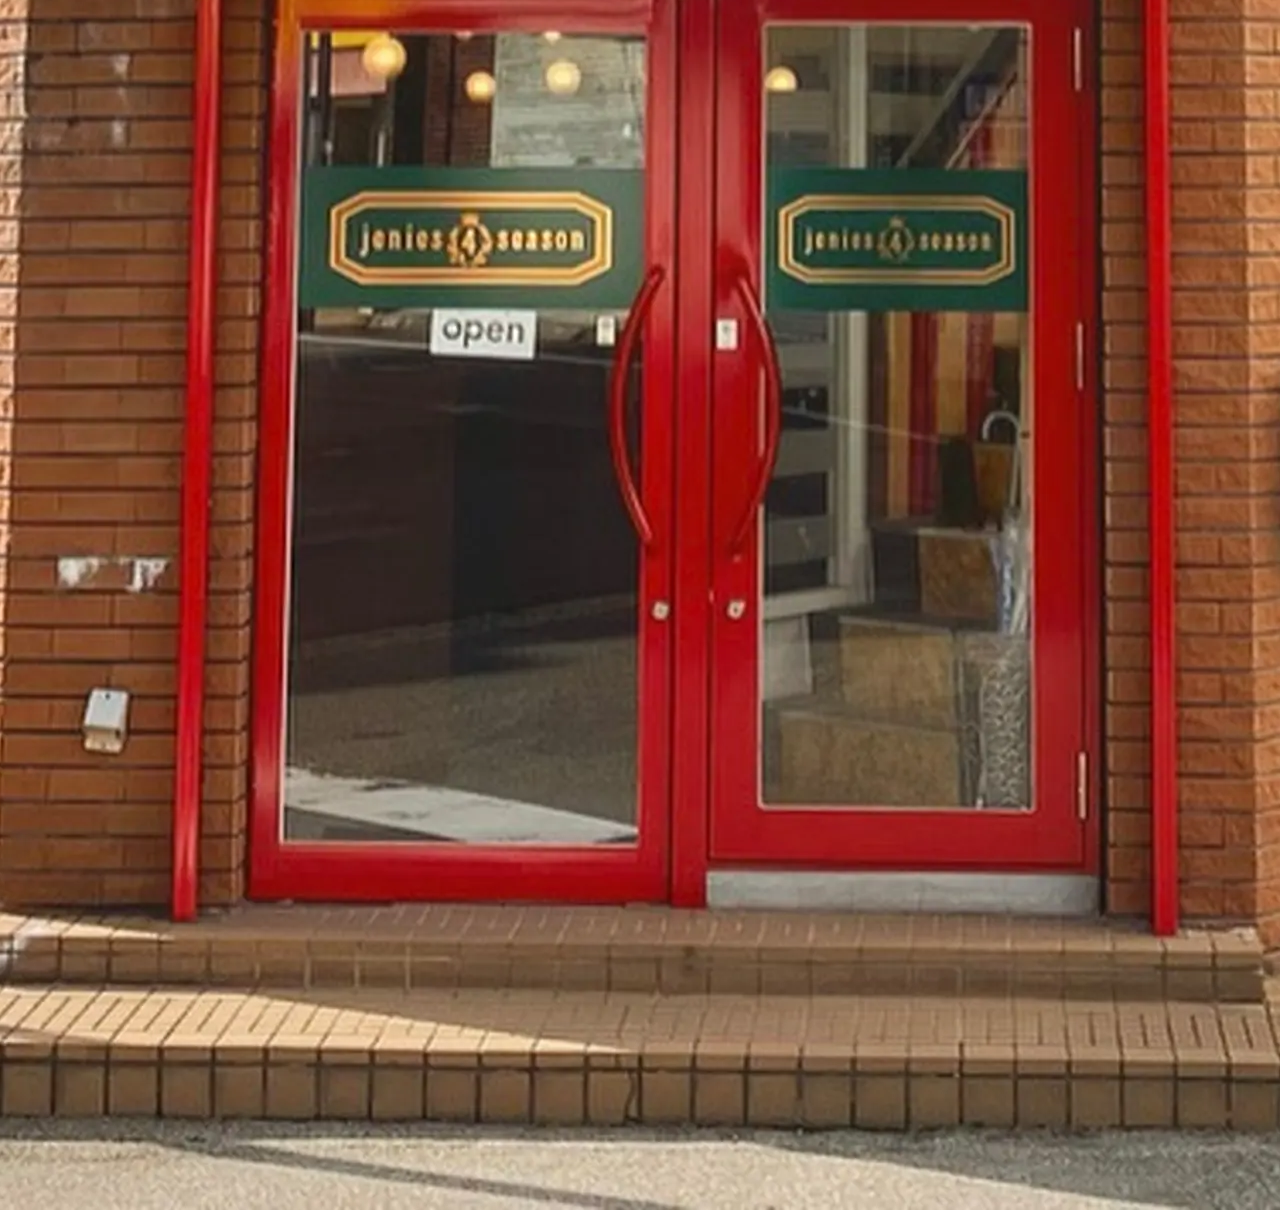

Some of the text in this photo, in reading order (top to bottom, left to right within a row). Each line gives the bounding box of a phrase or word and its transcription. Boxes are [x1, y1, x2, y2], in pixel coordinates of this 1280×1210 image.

[359, 222, 586, 257] jenies 4 season
[442, 312, 524, 348] open
